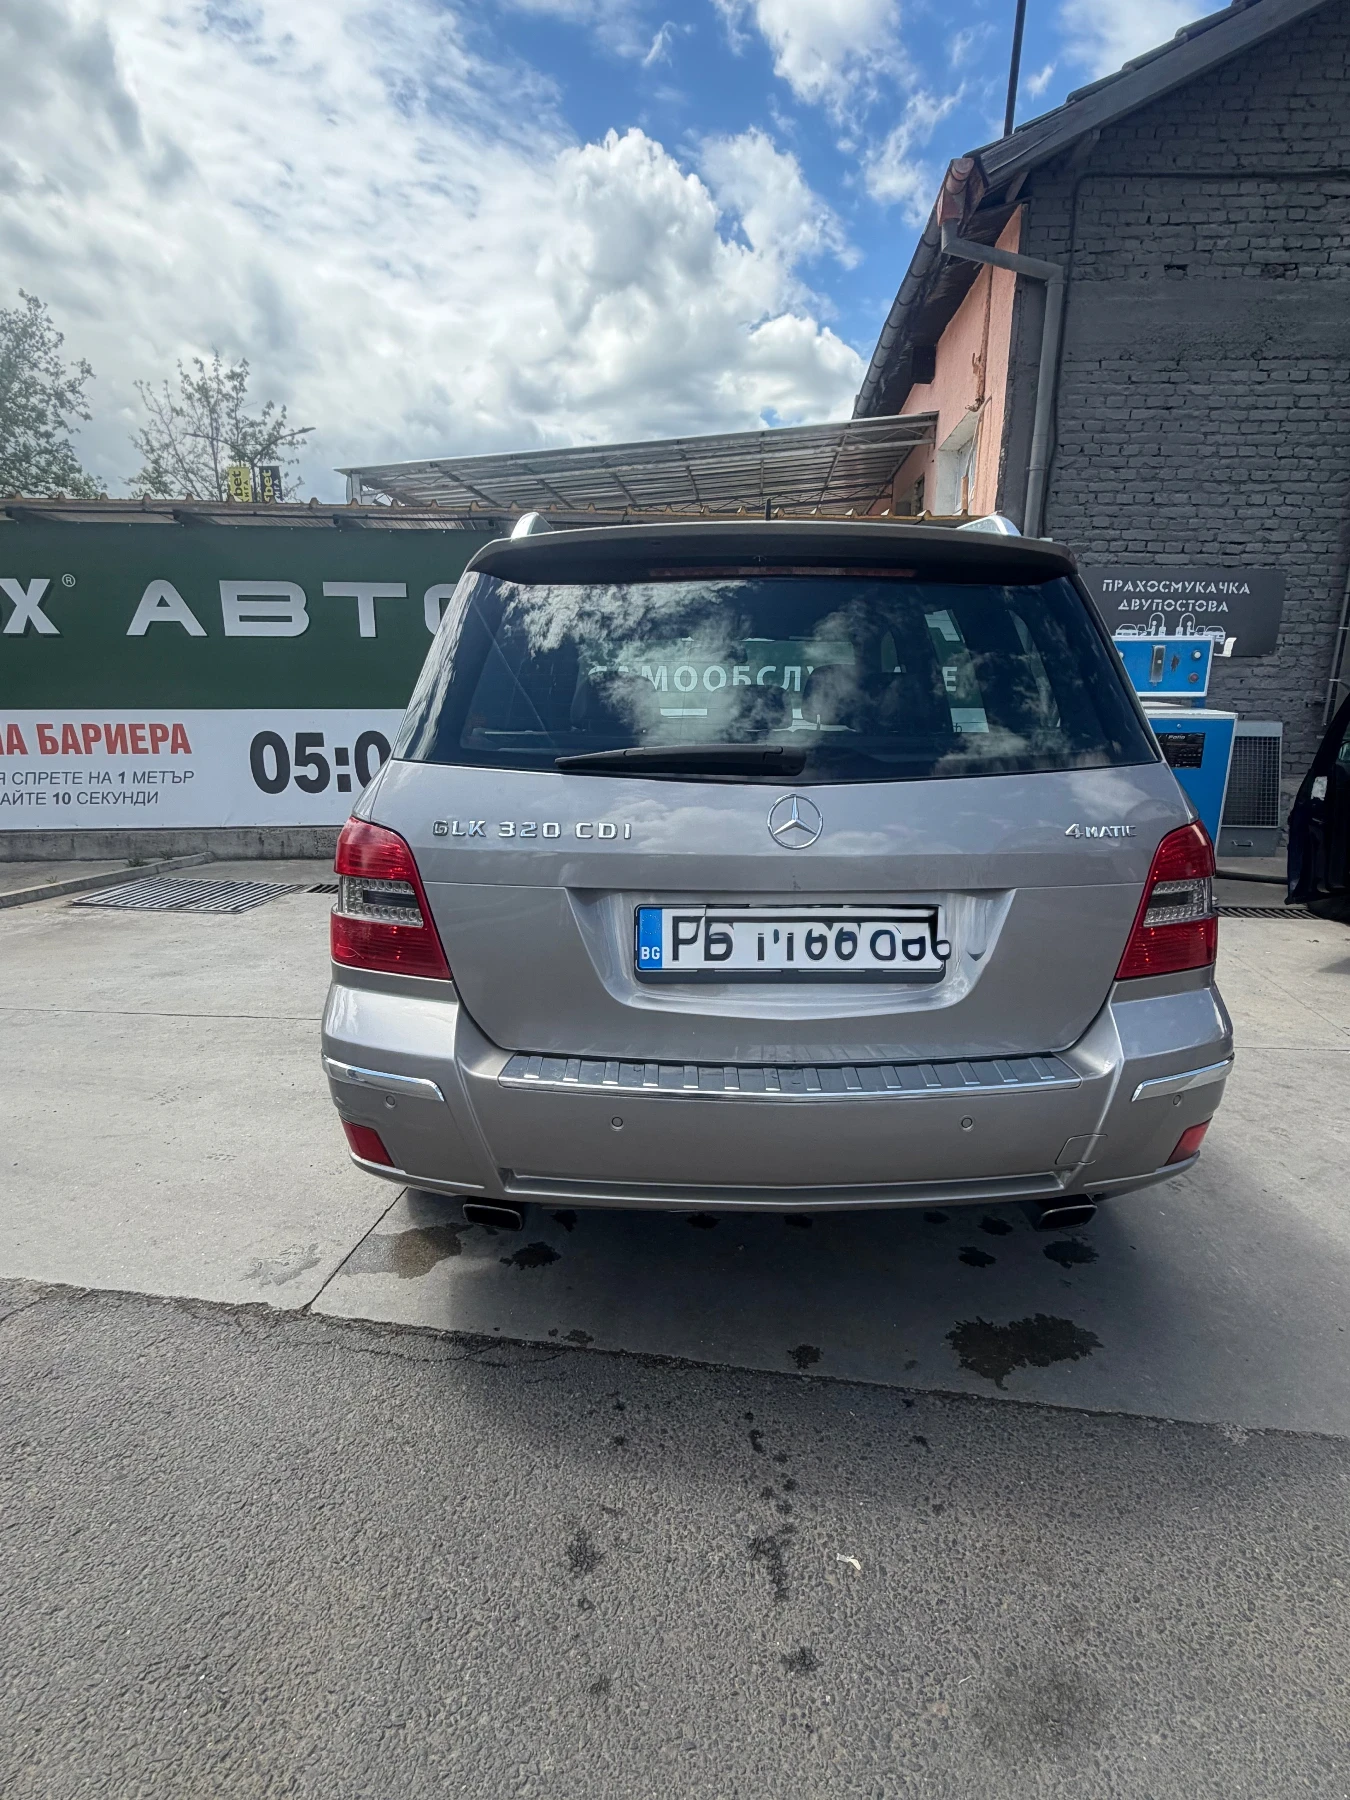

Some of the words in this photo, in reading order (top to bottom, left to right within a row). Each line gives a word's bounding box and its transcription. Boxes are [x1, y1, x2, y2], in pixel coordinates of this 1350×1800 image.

[1102, 579, 1251, 595] ПРАХОСМУКАЧКА
[1117, 598, 1229, 613] ДВУПОСТОВА
[0, 723, 29, 756] А
[35, 723, 193, 755] БАРИЕРА
[11, 771, 83, 786] СПРЕТЕ
[88, 771, 113, 785] НА
[118, 771, 126, 785] 1
[132, 770, 195, 785] МЕТЪР
[52, 791, 72, 805] 10
[76, 790, 159, 806] СЕКУНДИ
[432, 820, 487, 837] GLK
[498, 821, 562, 839] 320
[575, 822, 632, 839] CDI
[1064, 823, 1138, 839] 4MATIC
[640, 946, 661, 960] BG
